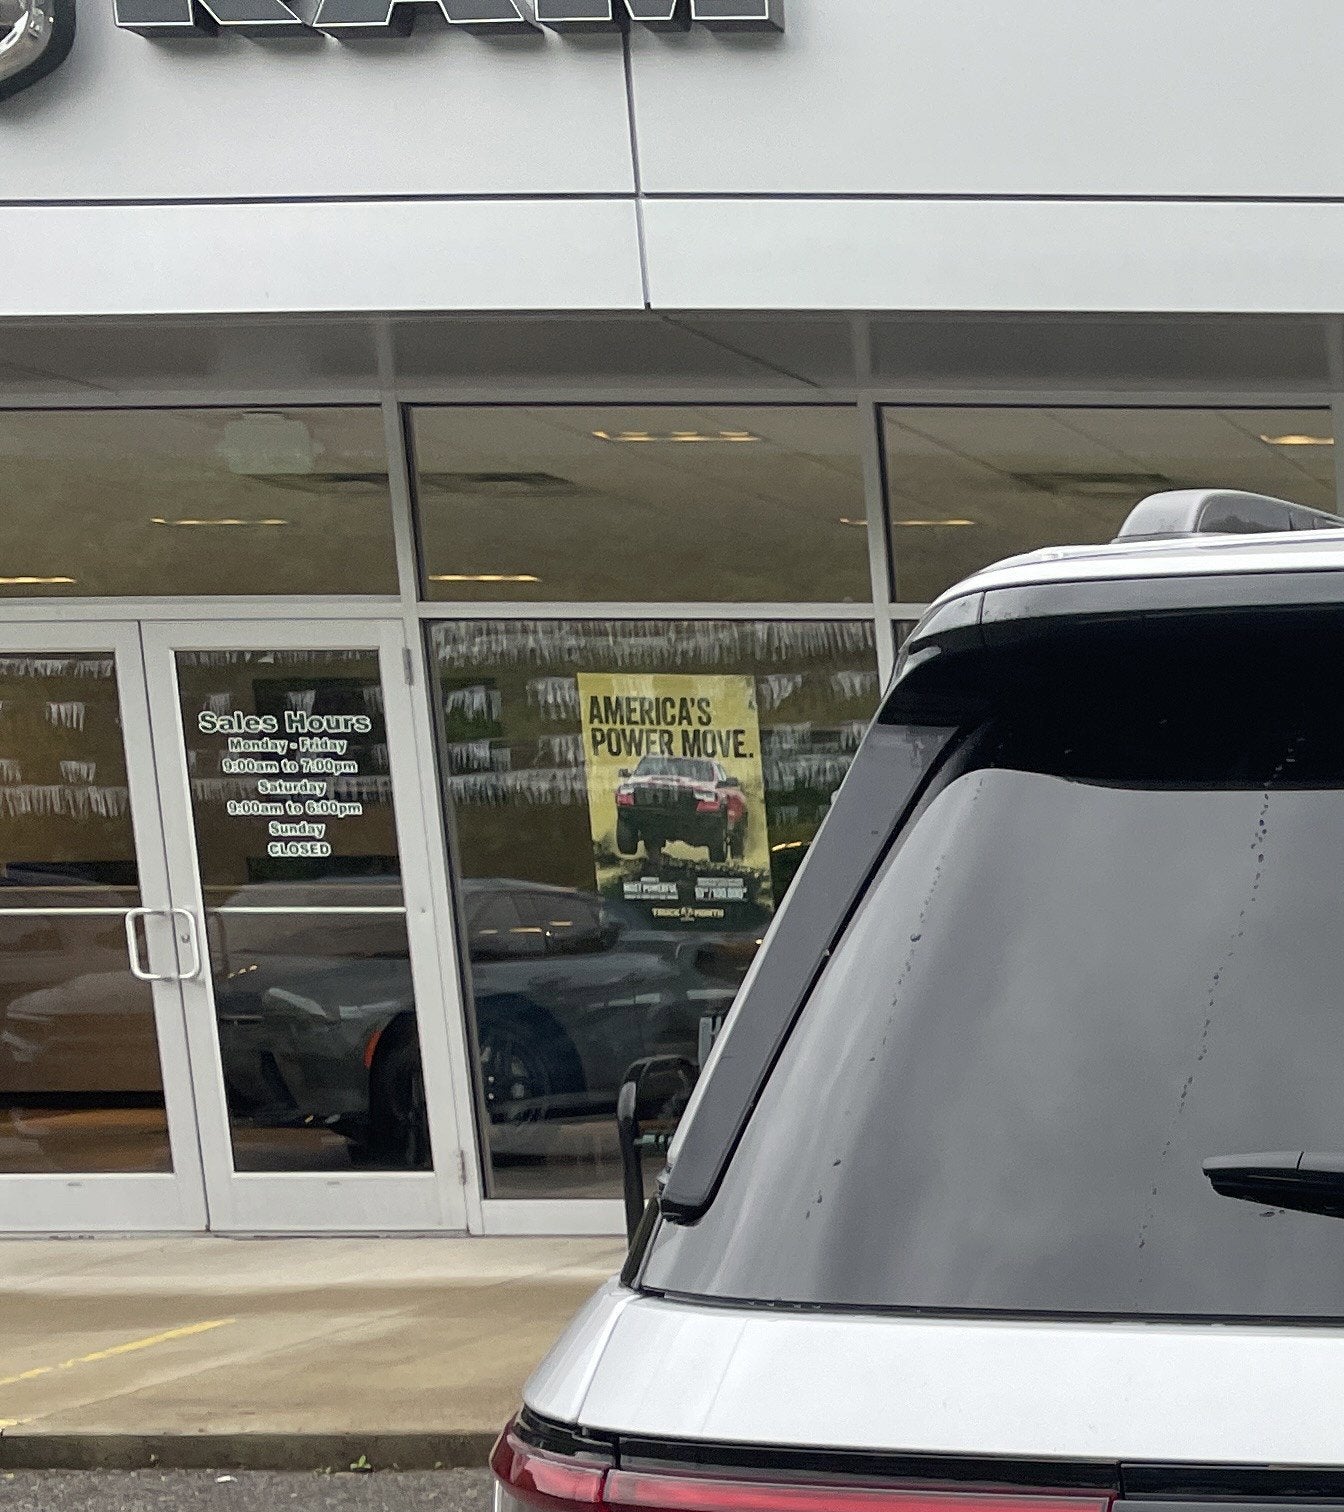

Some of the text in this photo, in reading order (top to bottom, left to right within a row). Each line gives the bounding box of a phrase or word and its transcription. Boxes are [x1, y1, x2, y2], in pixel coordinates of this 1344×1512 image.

[589, 695, 712, 727] AMERICA'S
[198, 710, 372, 733] Sales Hours
[228, 737, 288, 754] Monday
[299, 737, 347, 755] Friday
[590, 727, 754, 758] POWER MOVE.
[222, 759, 358, 775] 9:00am to 7:00pm
[257, 779, 327, 795] Saturday
[227, 801, 362, 818] 9:00am to 6:00pm
[268, 821, 326, 838] Sunday
[267, 842, 332, 857] CLOSED
